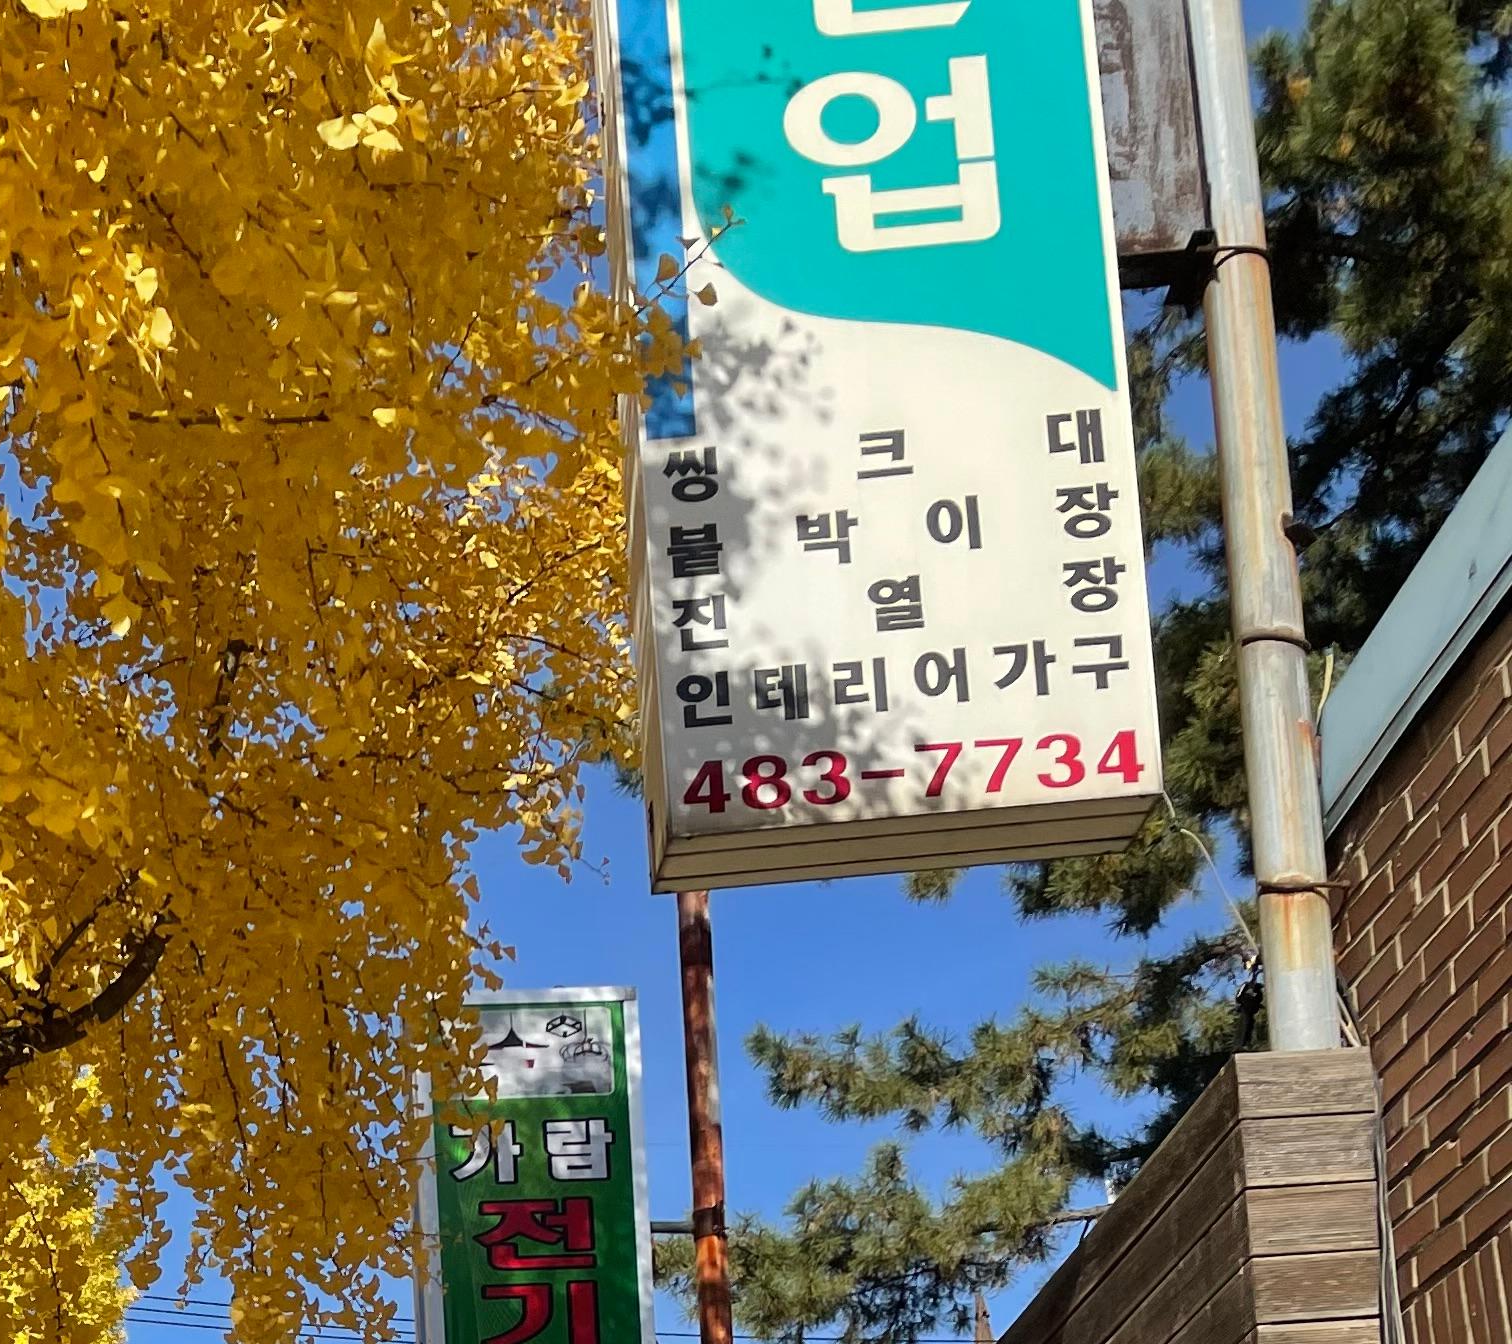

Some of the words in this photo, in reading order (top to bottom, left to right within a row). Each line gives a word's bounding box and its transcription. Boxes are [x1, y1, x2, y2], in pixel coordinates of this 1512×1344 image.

[784, 0, 1001, 252] 업
[675, 633, 1131, 730] 인테리어가구
[683, 728, 1147, 815] 483-7734
